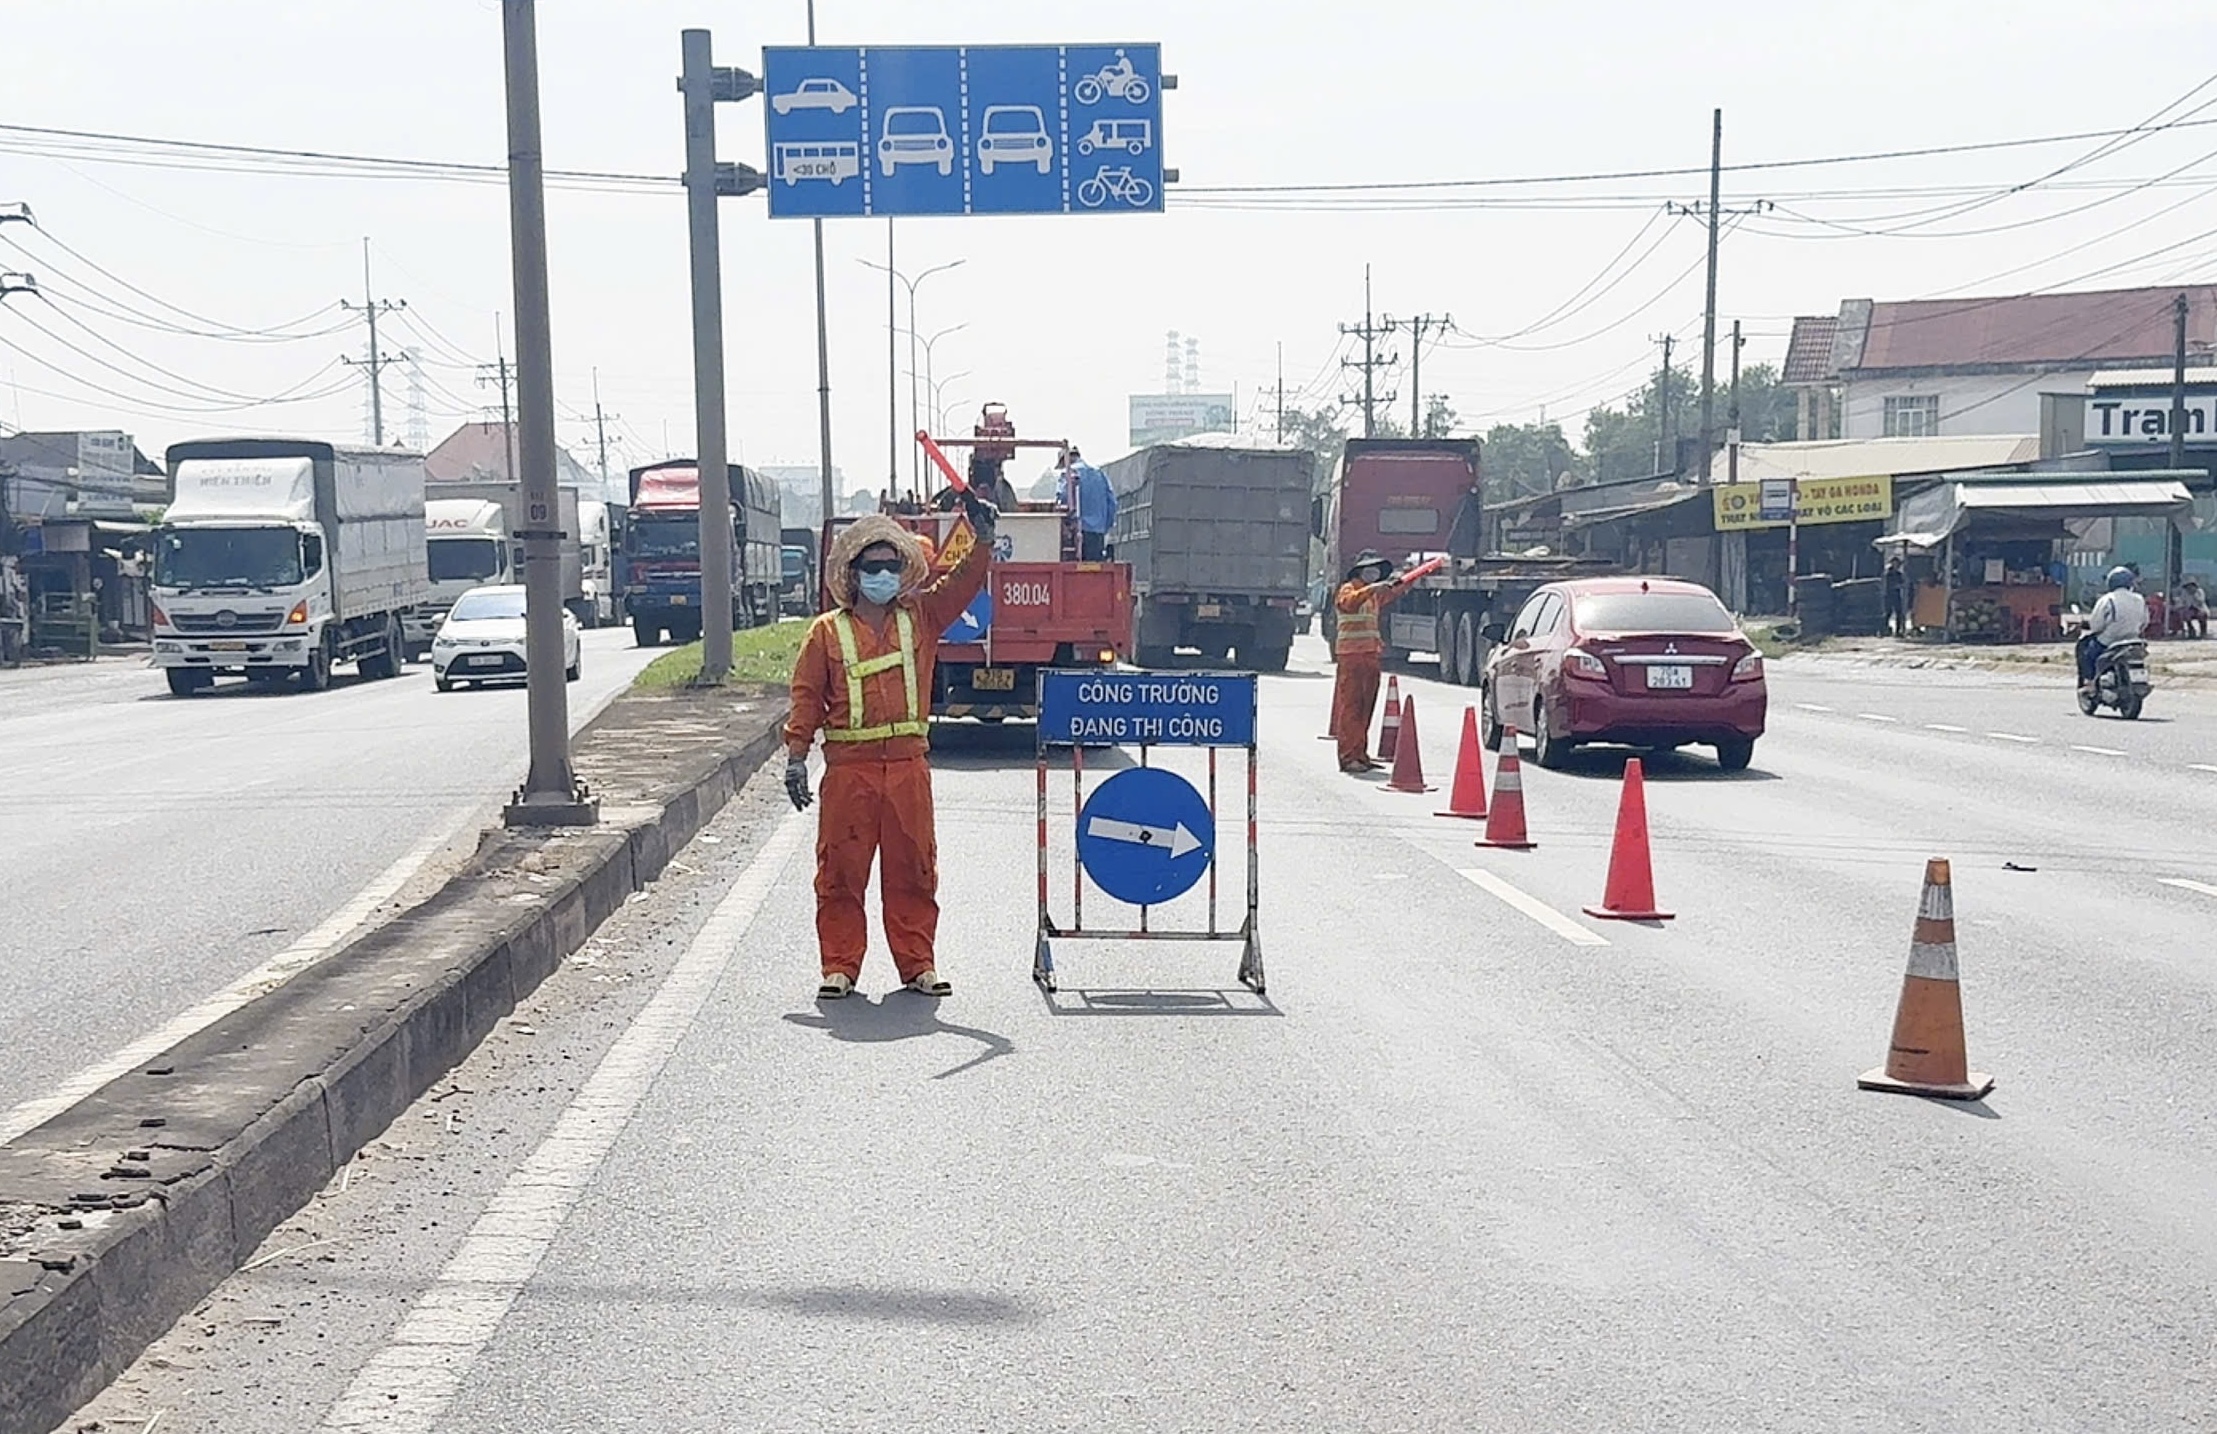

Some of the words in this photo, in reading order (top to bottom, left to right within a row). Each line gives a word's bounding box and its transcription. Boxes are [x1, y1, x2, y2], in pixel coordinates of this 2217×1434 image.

[2092, 402, 2204, 441] Trạm
[426, 519, 468, 529] JAC
[1003, 583, 1050, 605] 380.04
[1078, 679, 1133, 703] CÔNG
[1137, 679, 1219, 704] TRƯỜNG
[1070, 717, 1127, 737] ĐANG
[1132, 718, 1163, 737] THI
[1168, 713, 1223, 738] CÔNG
